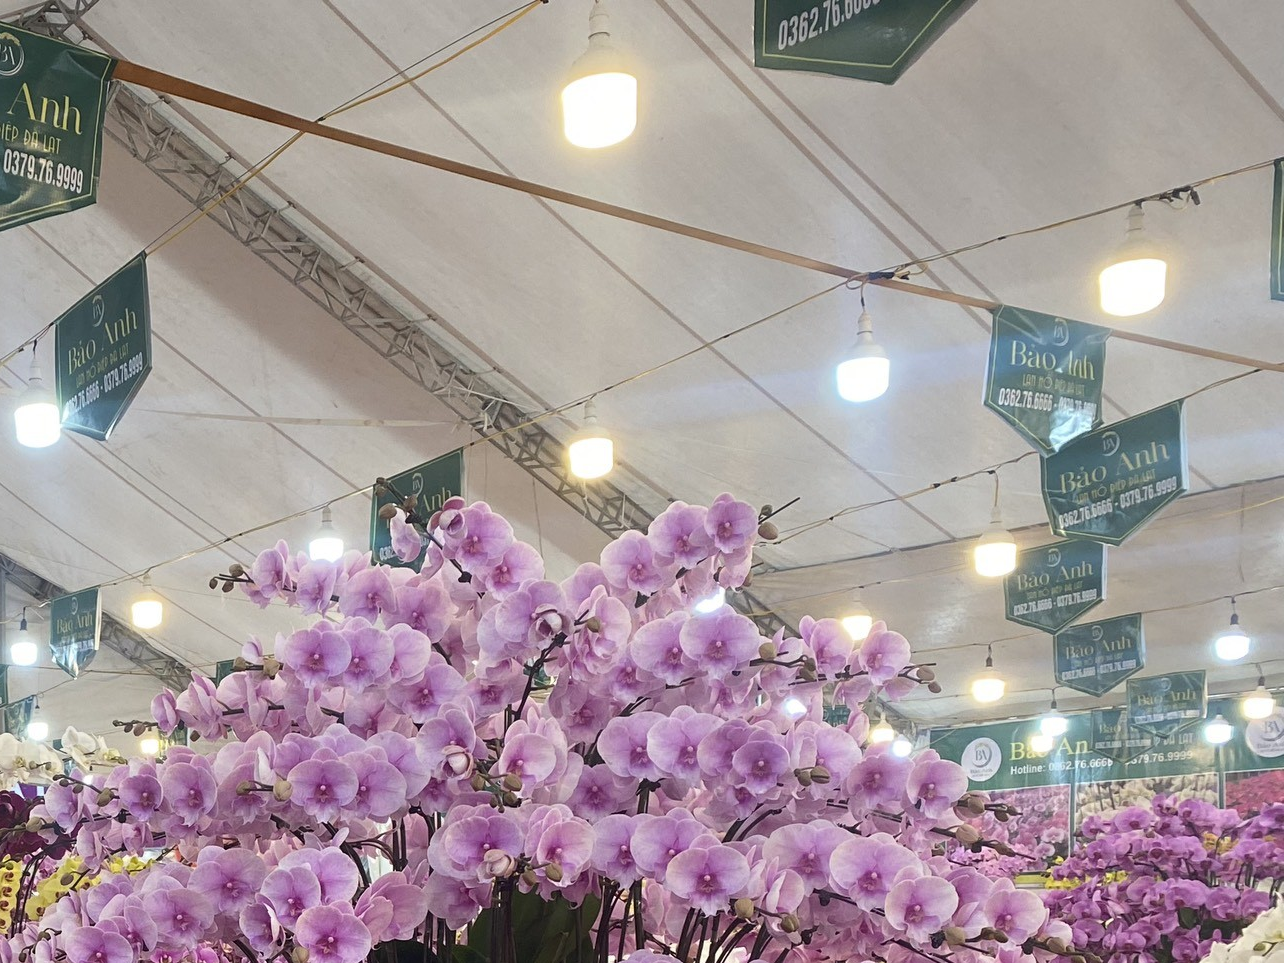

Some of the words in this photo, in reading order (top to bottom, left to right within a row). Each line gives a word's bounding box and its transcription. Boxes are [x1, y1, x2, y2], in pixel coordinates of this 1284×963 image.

[6, 82, 83, 135] Anh
[3, 152, 83, 194] 0379.76.9999
[998, 388, 1053, 412] 0362.76.6666
[1116, 441, 1170, 476] Anh
[1058, 498, 1113, 529] 0362.76.6666
[1119, 476, 1177, 509] 0379.76.9999
[1057, 561, 1094, 582] Anh
[1010, 763, 1046, 776] Hotline:
